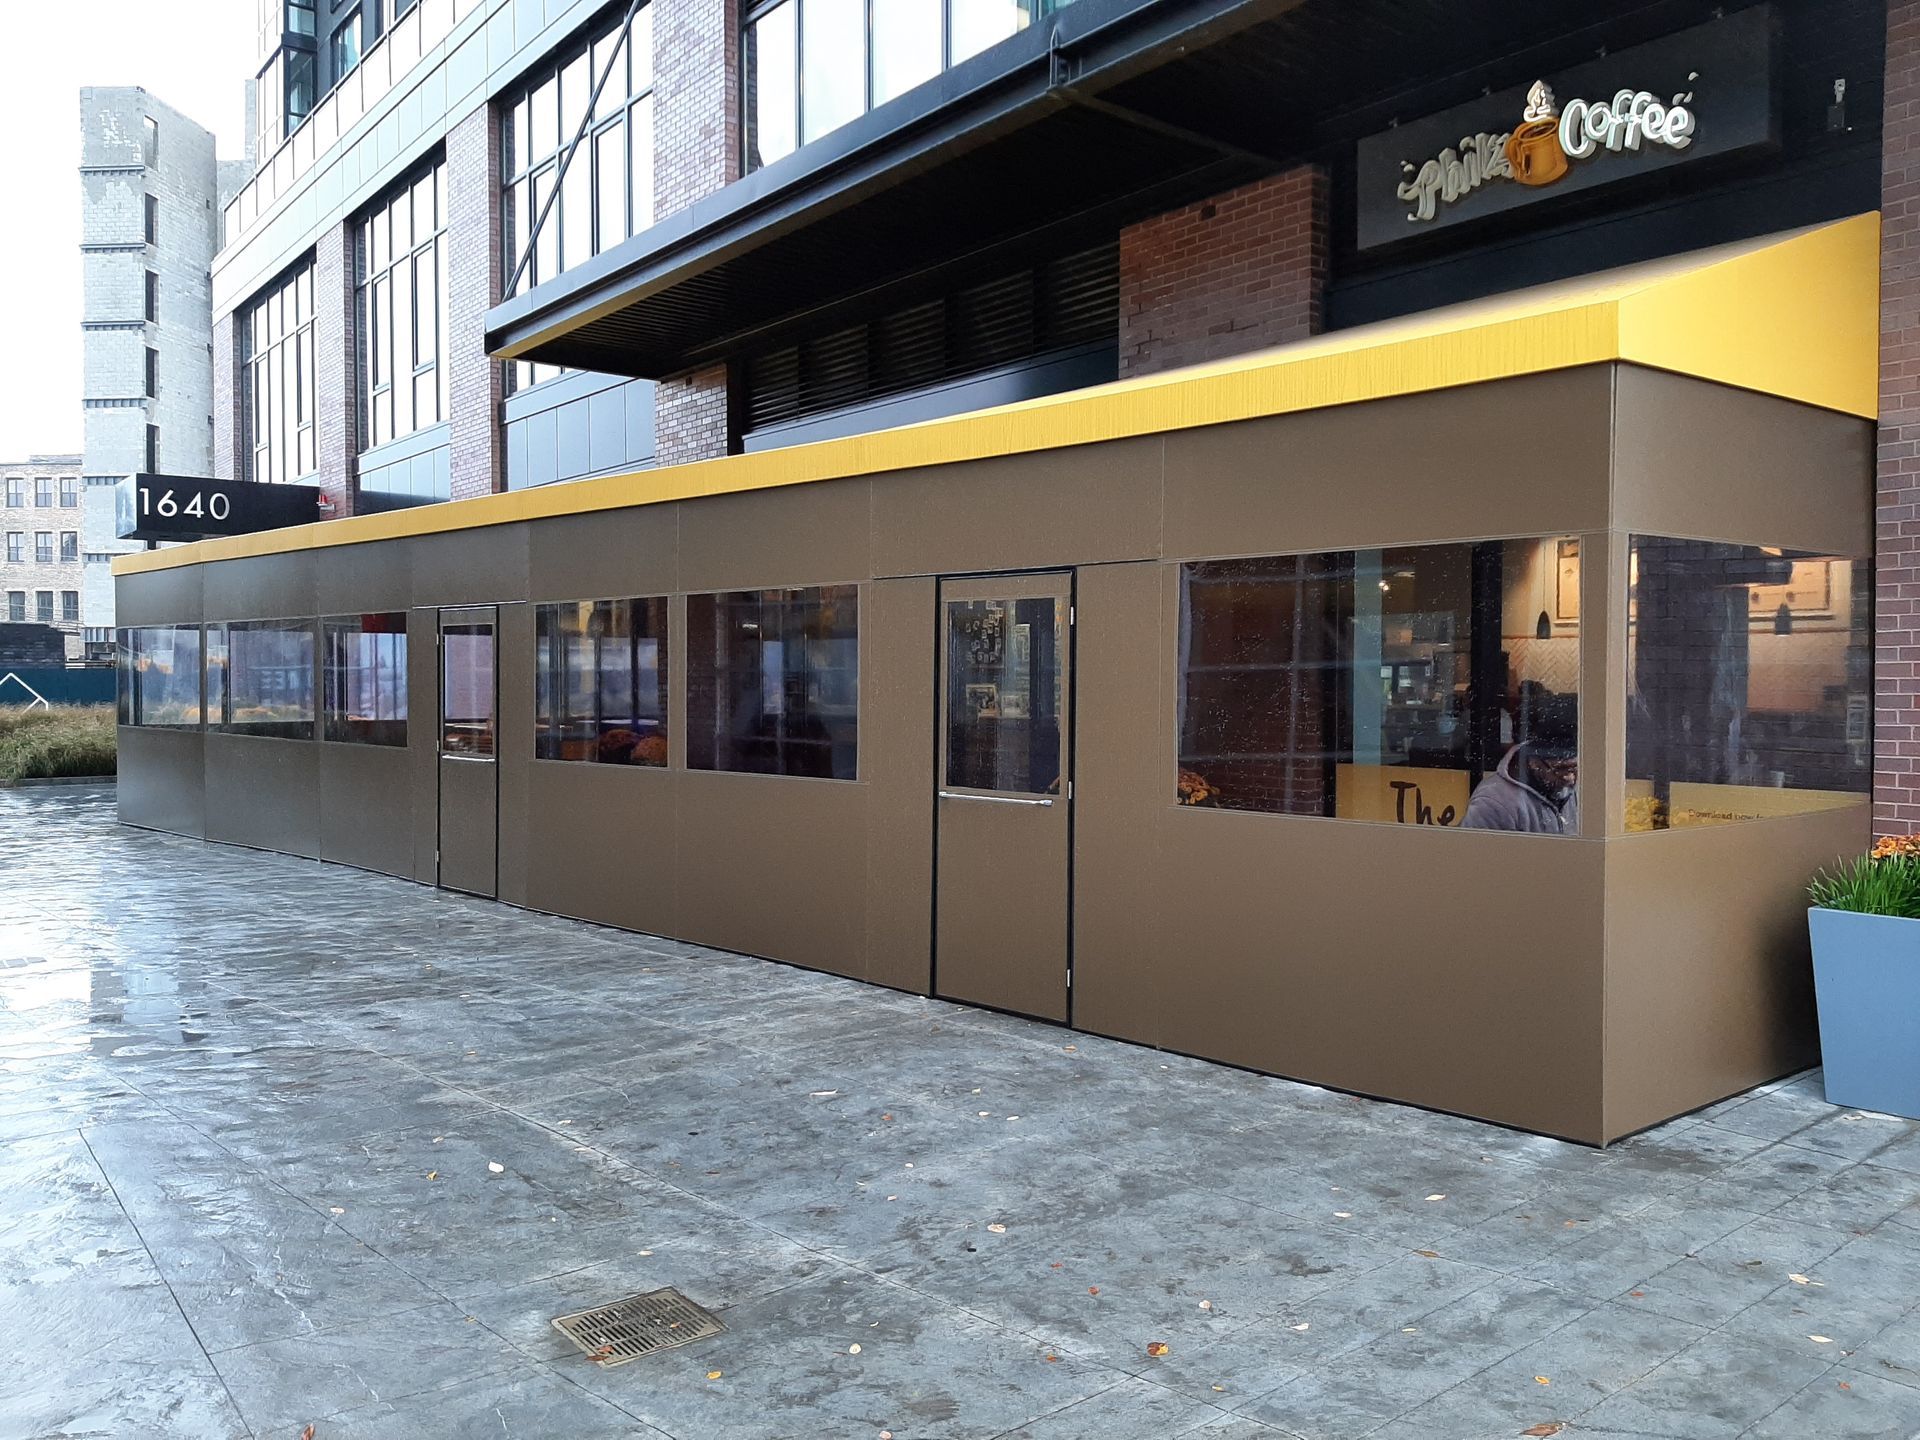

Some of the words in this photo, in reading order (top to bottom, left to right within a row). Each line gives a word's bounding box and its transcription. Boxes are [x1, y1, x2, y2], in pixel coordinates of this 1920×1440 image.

[1559, 88, 1695, 159] Coffee
[139, 487, 230, 520] 1640
[1390, 781, 1455, 826] The
